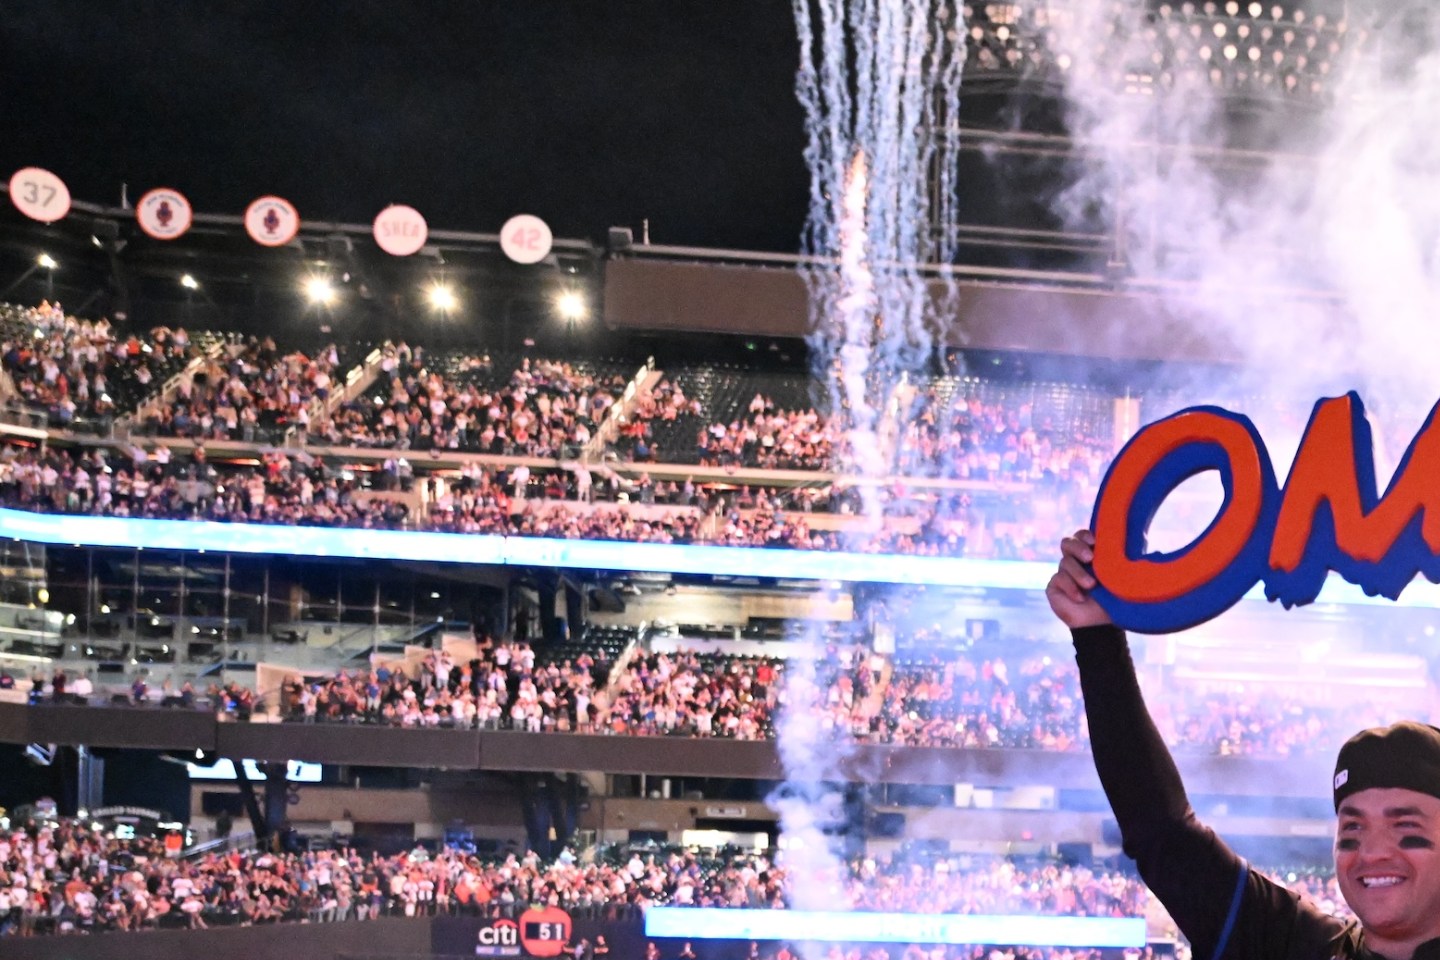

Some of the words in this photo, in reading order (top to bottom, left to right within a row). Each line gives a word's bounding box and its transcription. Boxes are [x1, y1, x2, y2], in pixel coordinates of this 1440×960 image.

[23, 181, 57, 208] 37
[381, 221, 419, 238] SHEA
[511, 228, 542, 251] 42
[479, 920, 517, 945] citi
[539, 923, 563, 940] 51
